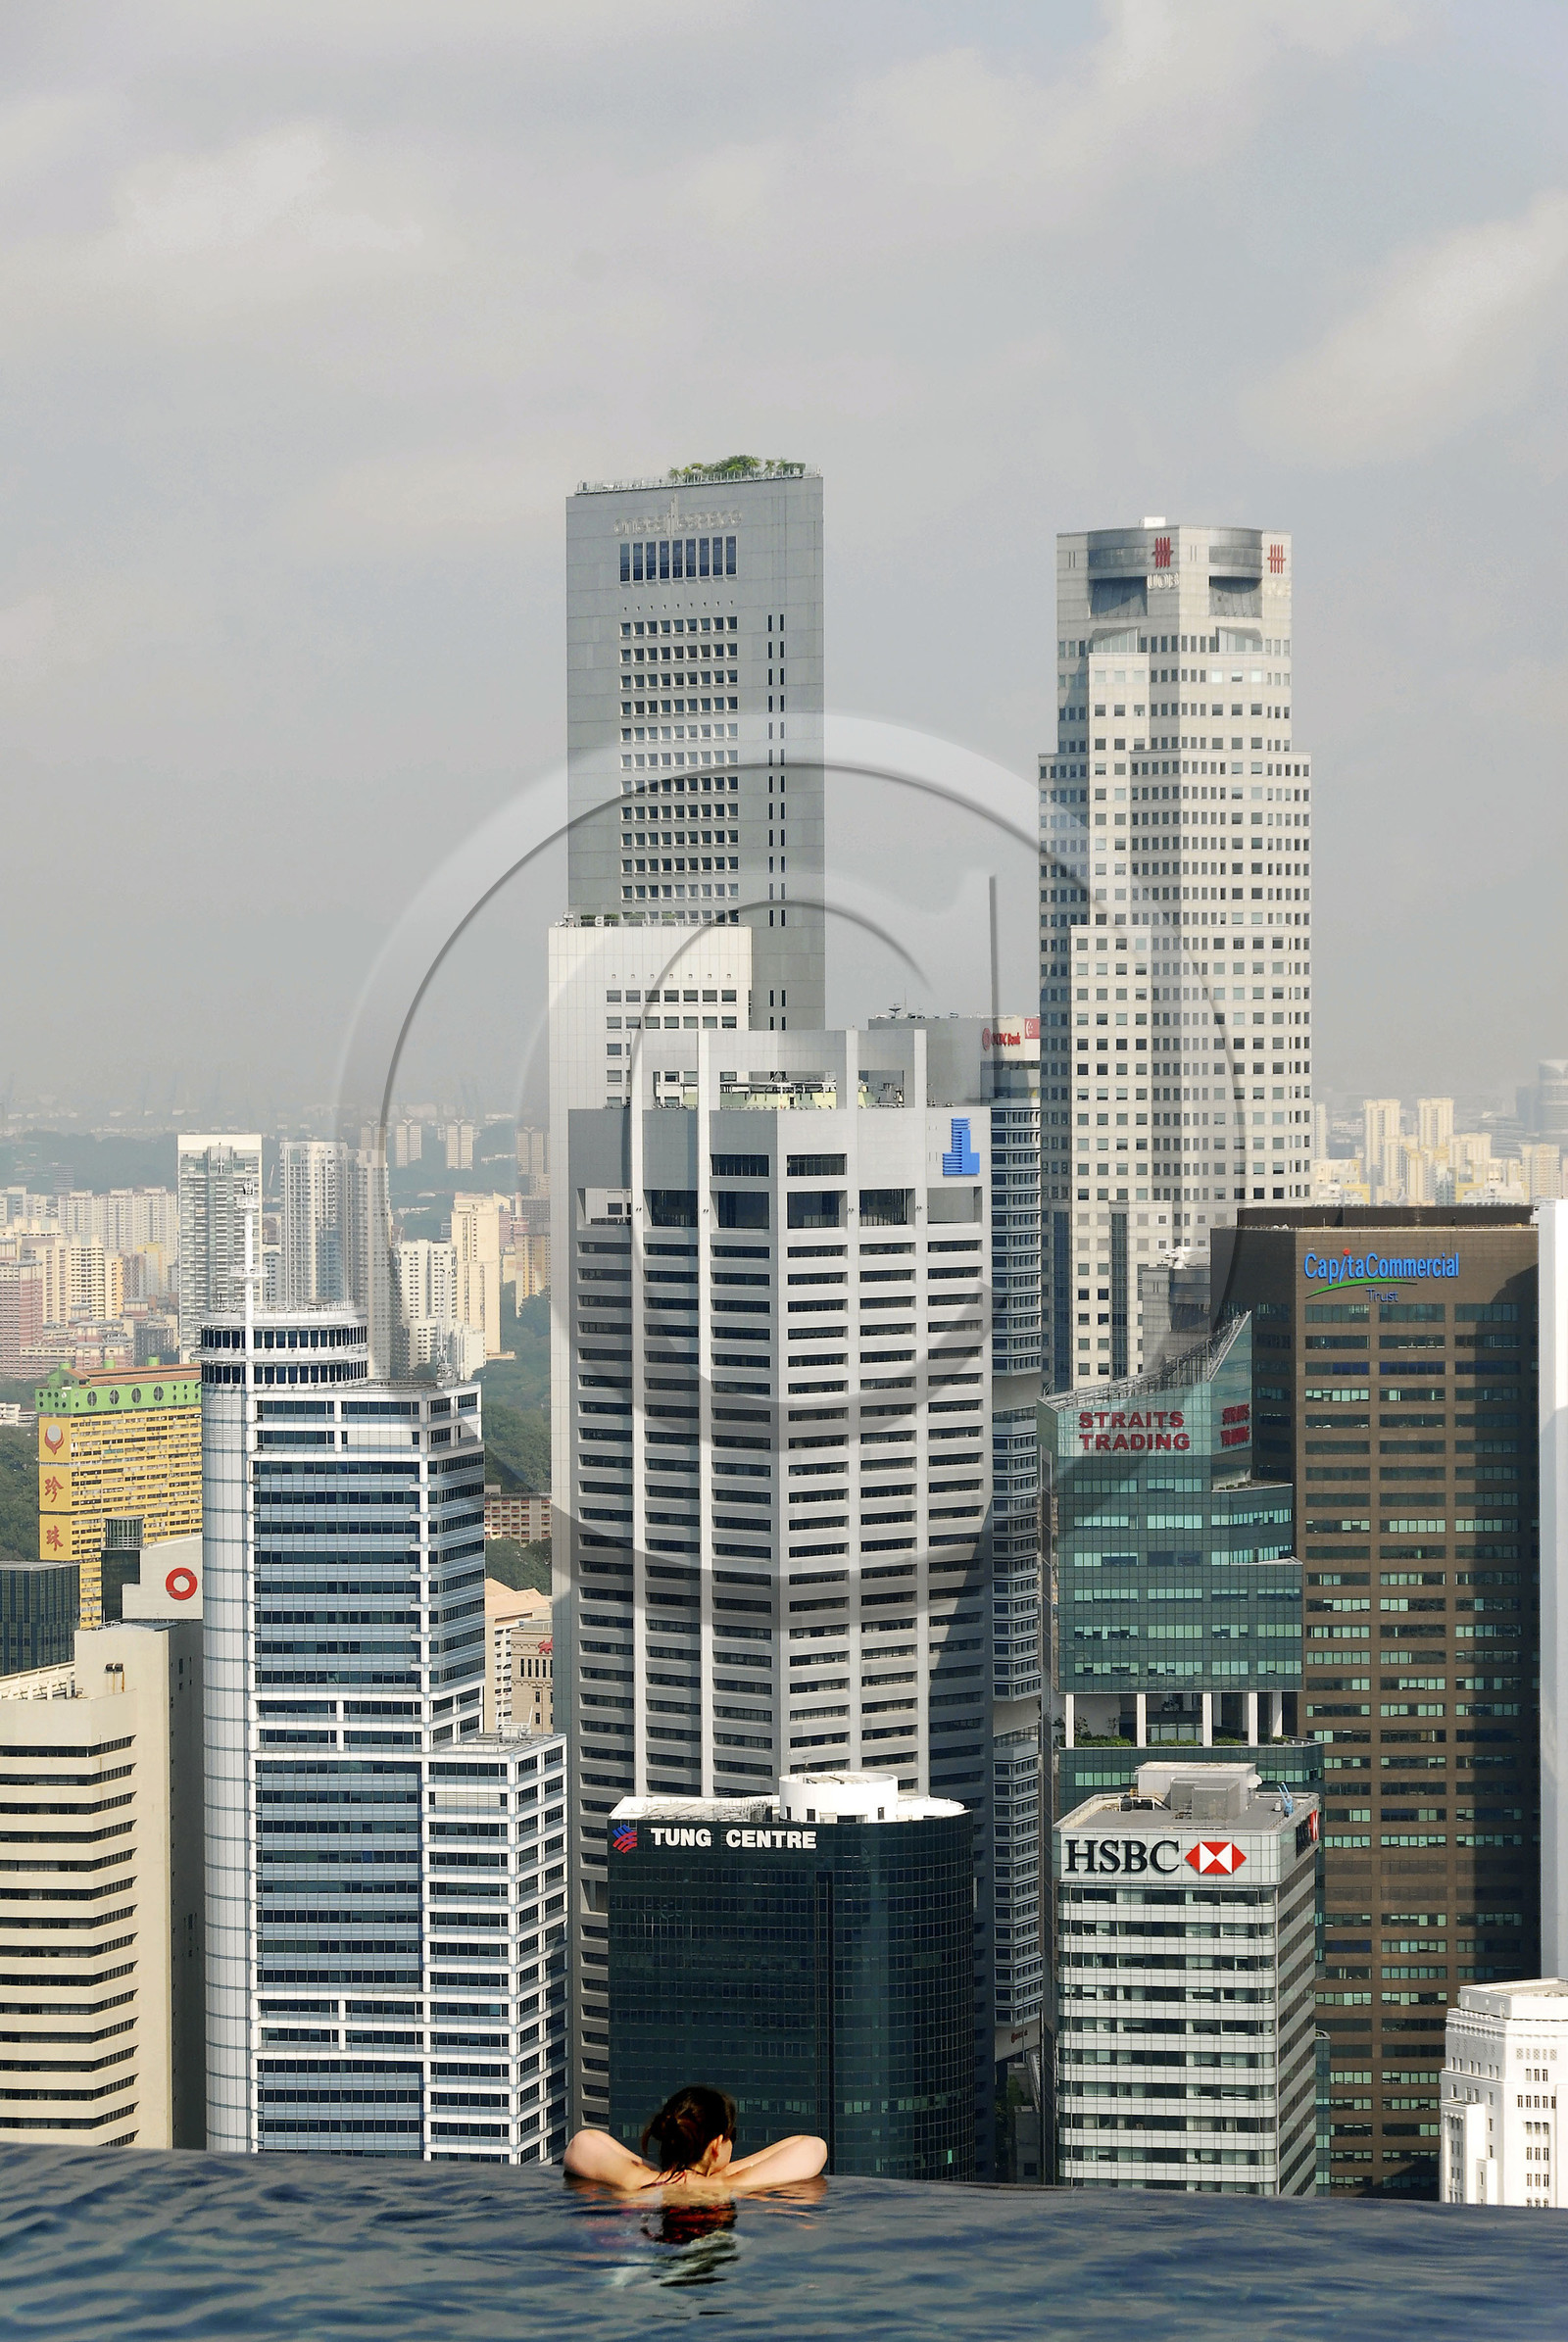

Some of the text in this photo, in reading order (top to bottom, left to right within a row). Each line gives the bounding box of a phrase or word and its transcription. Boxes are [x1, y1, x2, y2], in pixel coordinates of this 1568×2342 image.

[1147, 572, 1179, 590] UOB
[1304, 1248, 1460, 1285] CapitaCommercial
[1365, 1289, 1399, 1302] Trust
[1079, 1411, 1185, 1429] STRAITS
[1079, 1434, 1191, 1450] TRADING
[650, 1828, 817, 1849] TUNG CENTRE
[1064, 1839, 1180, 1874] HSBC
